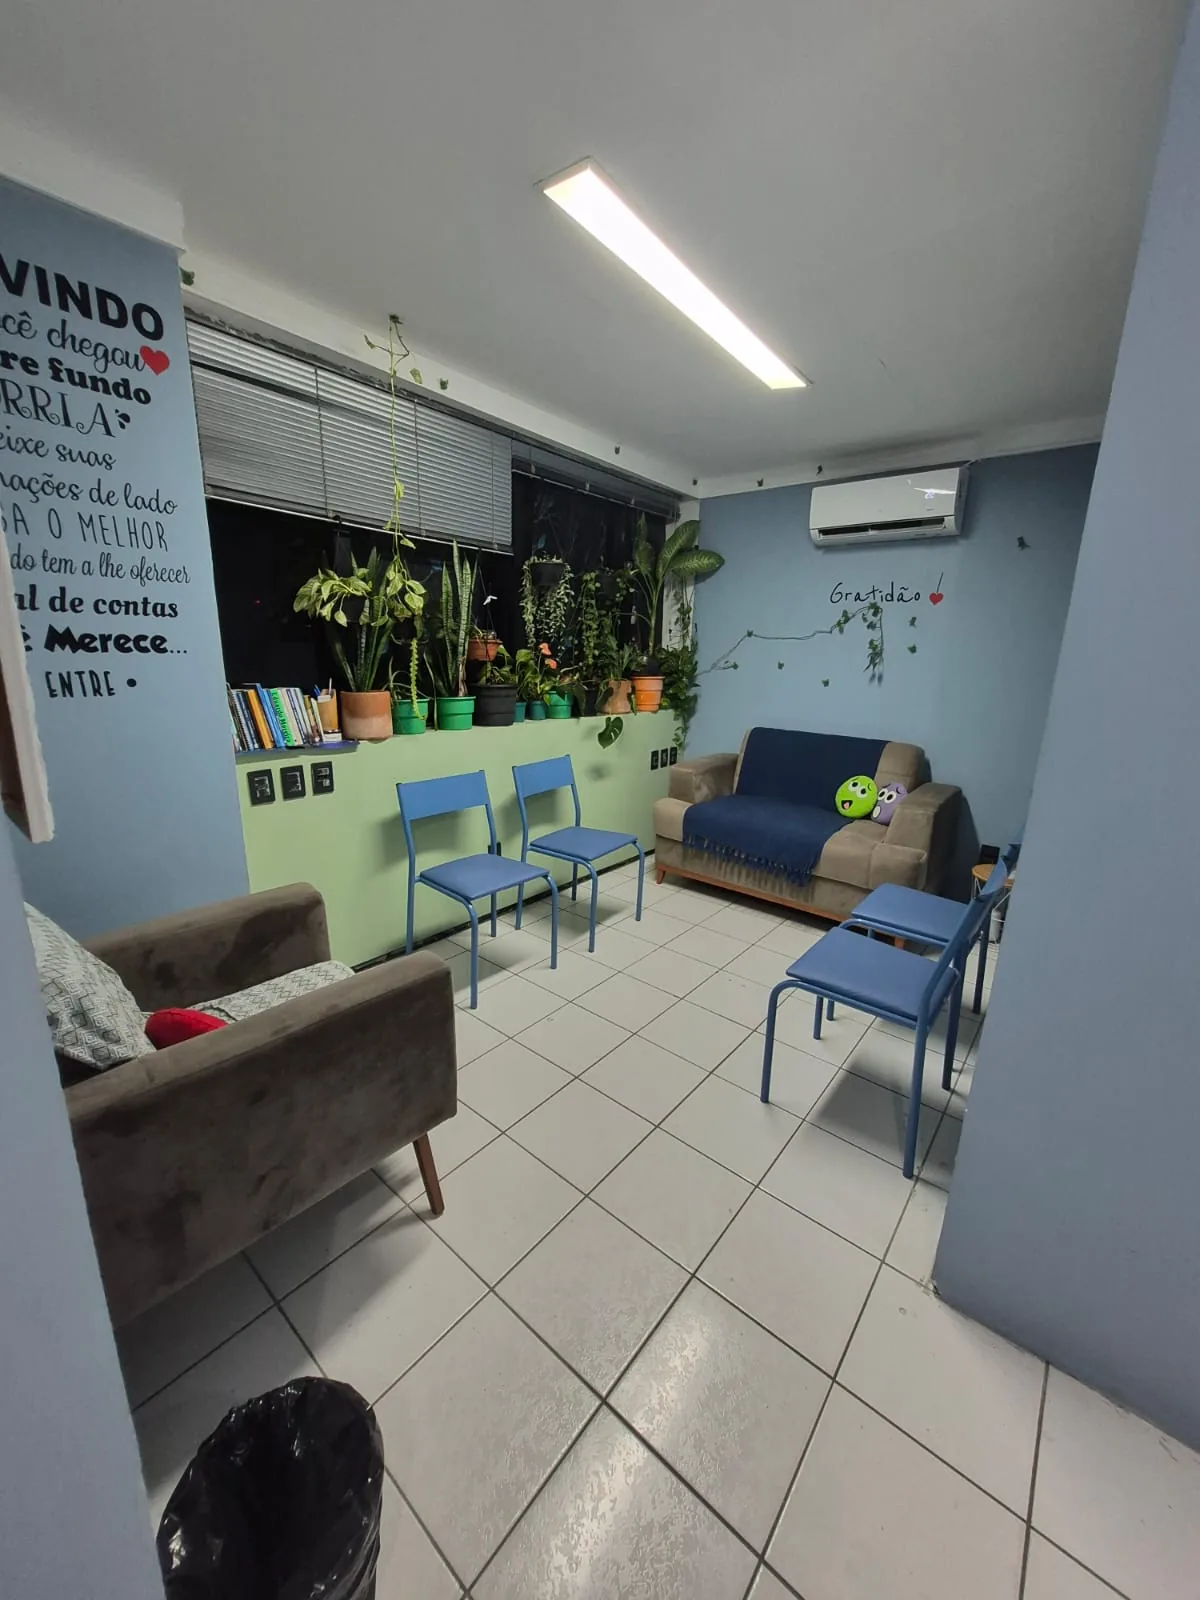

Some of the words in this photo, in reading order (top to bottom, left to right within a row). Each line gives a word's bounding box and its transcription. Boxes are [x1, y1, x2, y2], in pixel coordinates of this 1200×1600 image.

[0, 252, 164, 341] VINDO
[0, 311, 38, 340] cê
[47, 319, 146, 374] chegou
[48, 357, 151, 405] fundo
[0, 378, 116, 438] RRIA
[56, 444, 116, 471] suas
[89, 478, 119, 507] de
[124, 483, 178, 515] lado
[48, 508, 62, 539] O
[78, 512, 168, 552] MELHOR
[10, 543, 36, 571] do
[41, 550, 77, 576] tem
[82, 563, 94, 577] a
[100, 552, 126, 579] lhe
[130, 556, 191, 587] oferecer
[49, 586, 84, 614] de
[93, 597, 179, 618] contas
[830, 581, 921, 604] Gratidão
[45, 670, 116, 698] ENTRE
